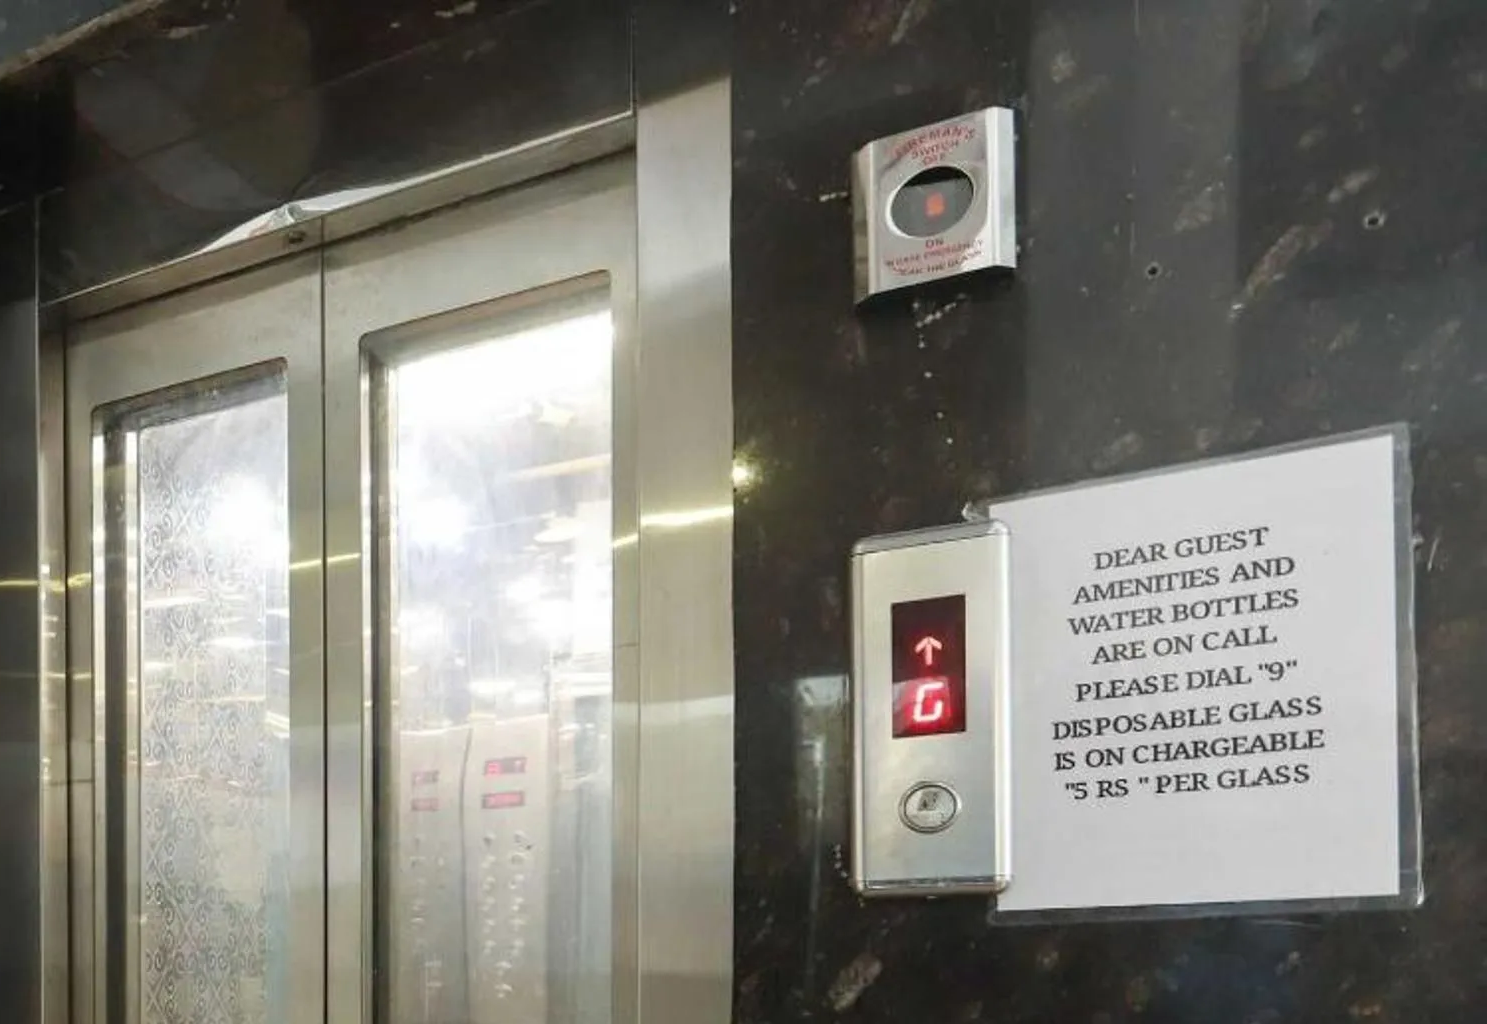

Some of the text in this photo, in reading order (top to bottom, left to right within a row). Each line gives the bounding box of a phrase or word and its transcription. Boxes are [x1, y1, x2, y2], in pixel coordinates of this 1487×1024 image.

[1093, 526, 1269, 571] DEAR GUEST
[1071, 556, 1296, 605] AMENITIES AND
[1067, 588, 1300, 636] WATER BOTTLES
[1091, 624, 1278, 665] ARE ON CALL
[1074, 660, 1298, 702] PLEASE DIAL "9"
[1051, 695, 1323, 740] DISPOSABLE GLASS
[1054, 729, 1326, 771] IS ON CHARGEABLE
[1097, 777, 1130, 798] RS
[1154, 772, 1211, 794] PER
[1216, 763, 1311, 789] GLASS
